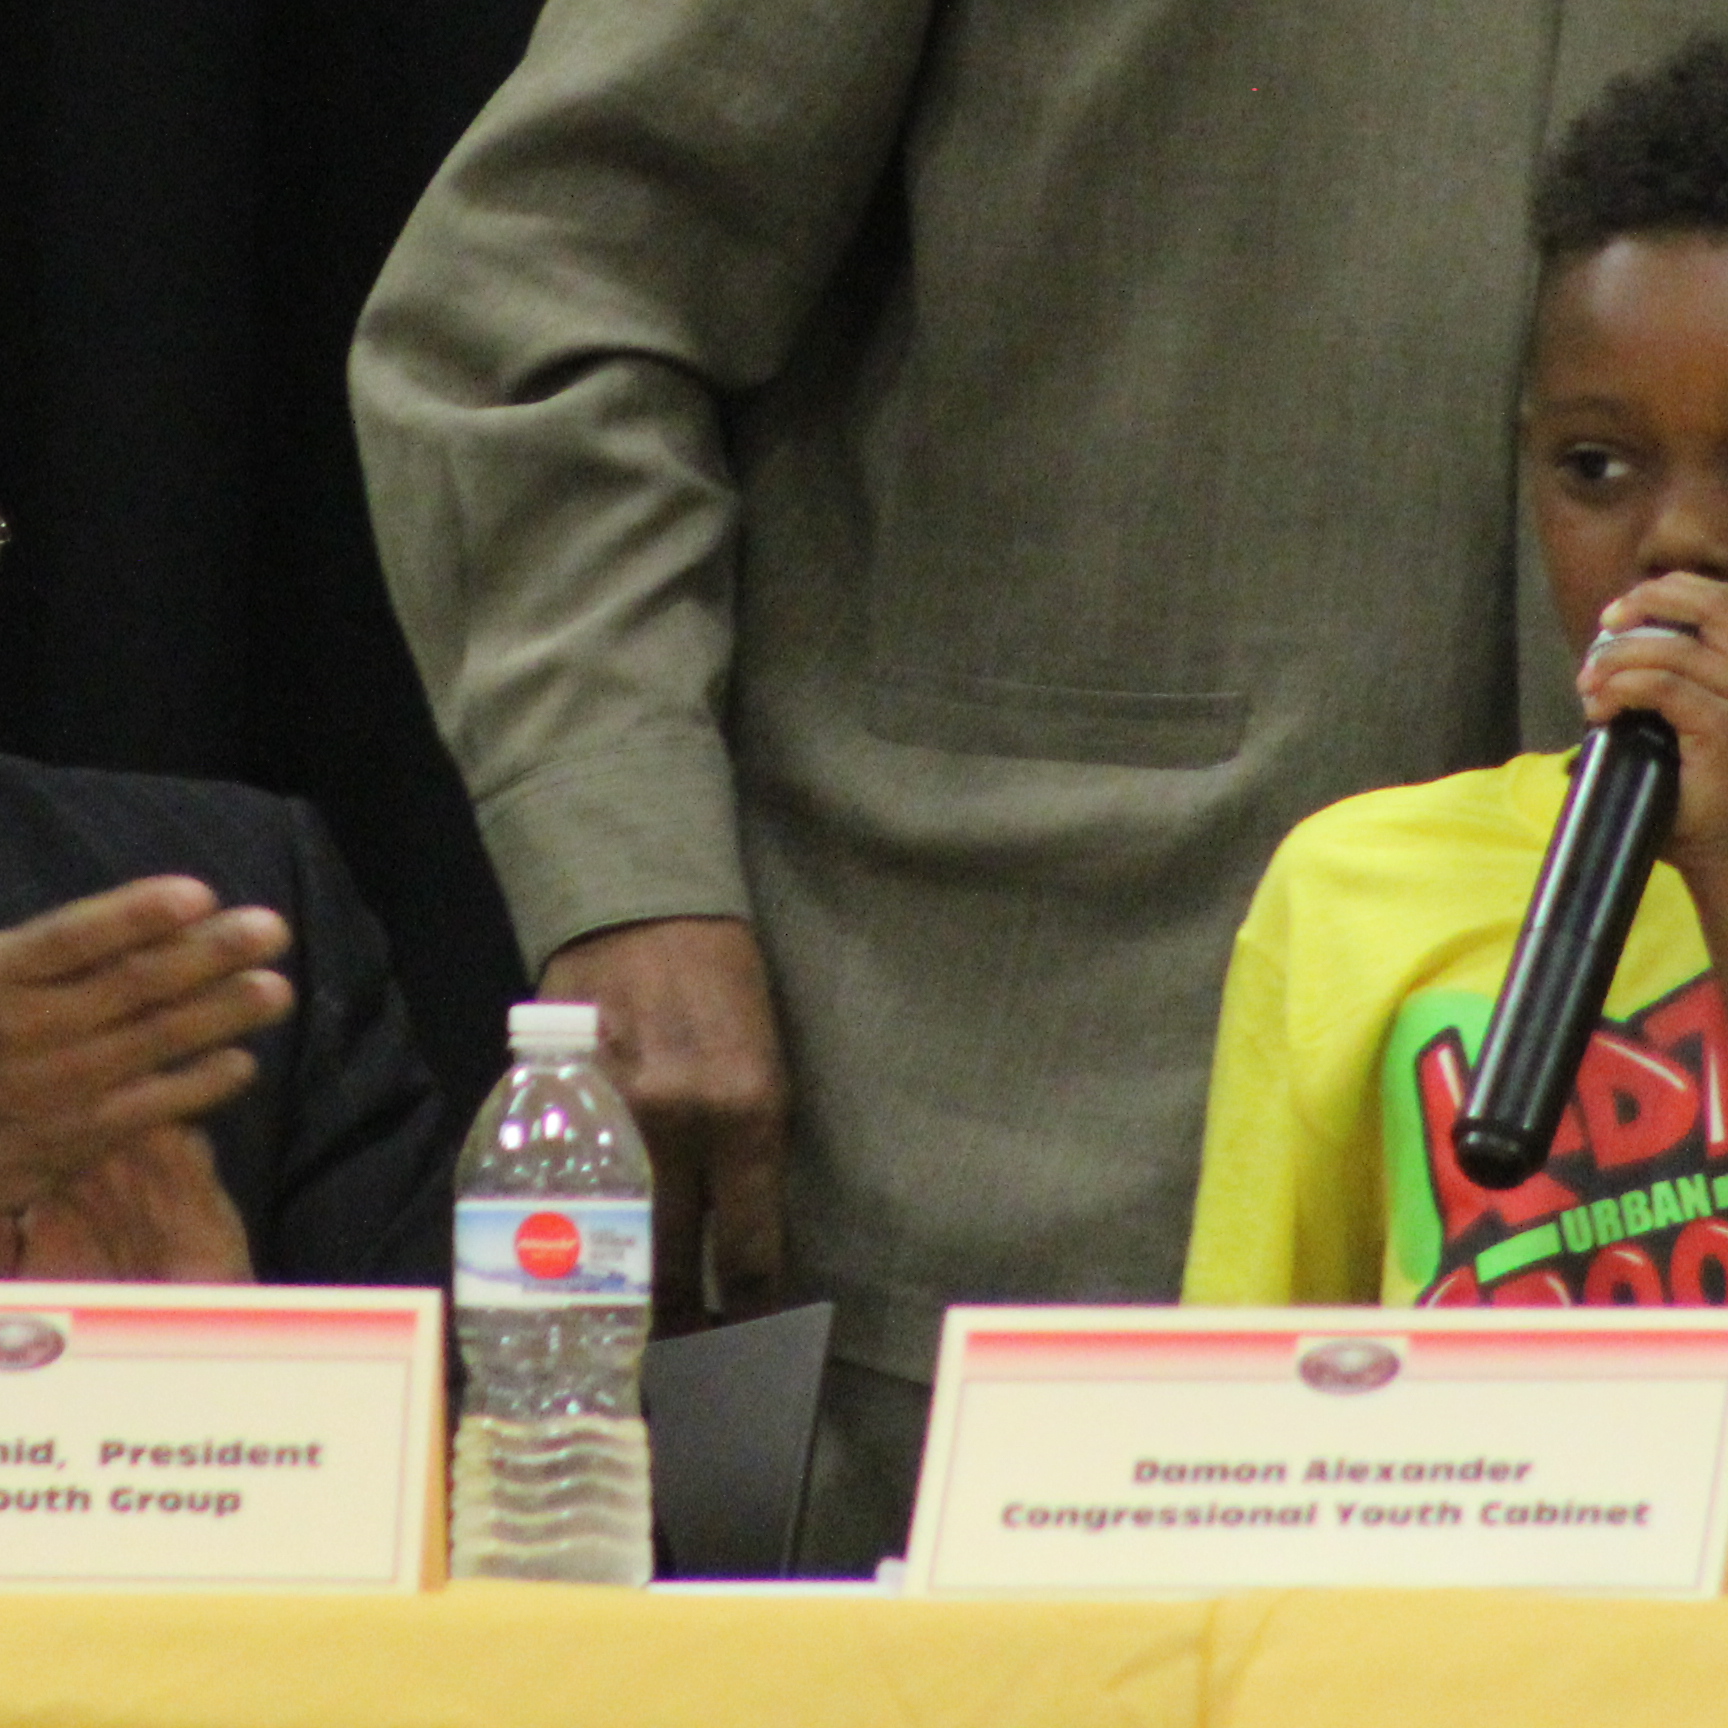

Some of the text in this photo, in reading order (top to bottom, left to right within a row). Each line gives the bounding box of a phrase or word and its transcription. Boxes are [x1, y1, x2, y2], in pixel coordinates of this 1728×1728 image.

[1558, 1172, 1713, 1254] URBAN
[99, 1440, 323, 1468] President
[1132, 1458, 1534, 1484] Damon Alexander
[108, 1487, 243, 1517] Group
[1001, 1502, 1652, 1533] Congressional Youth Cabinet
